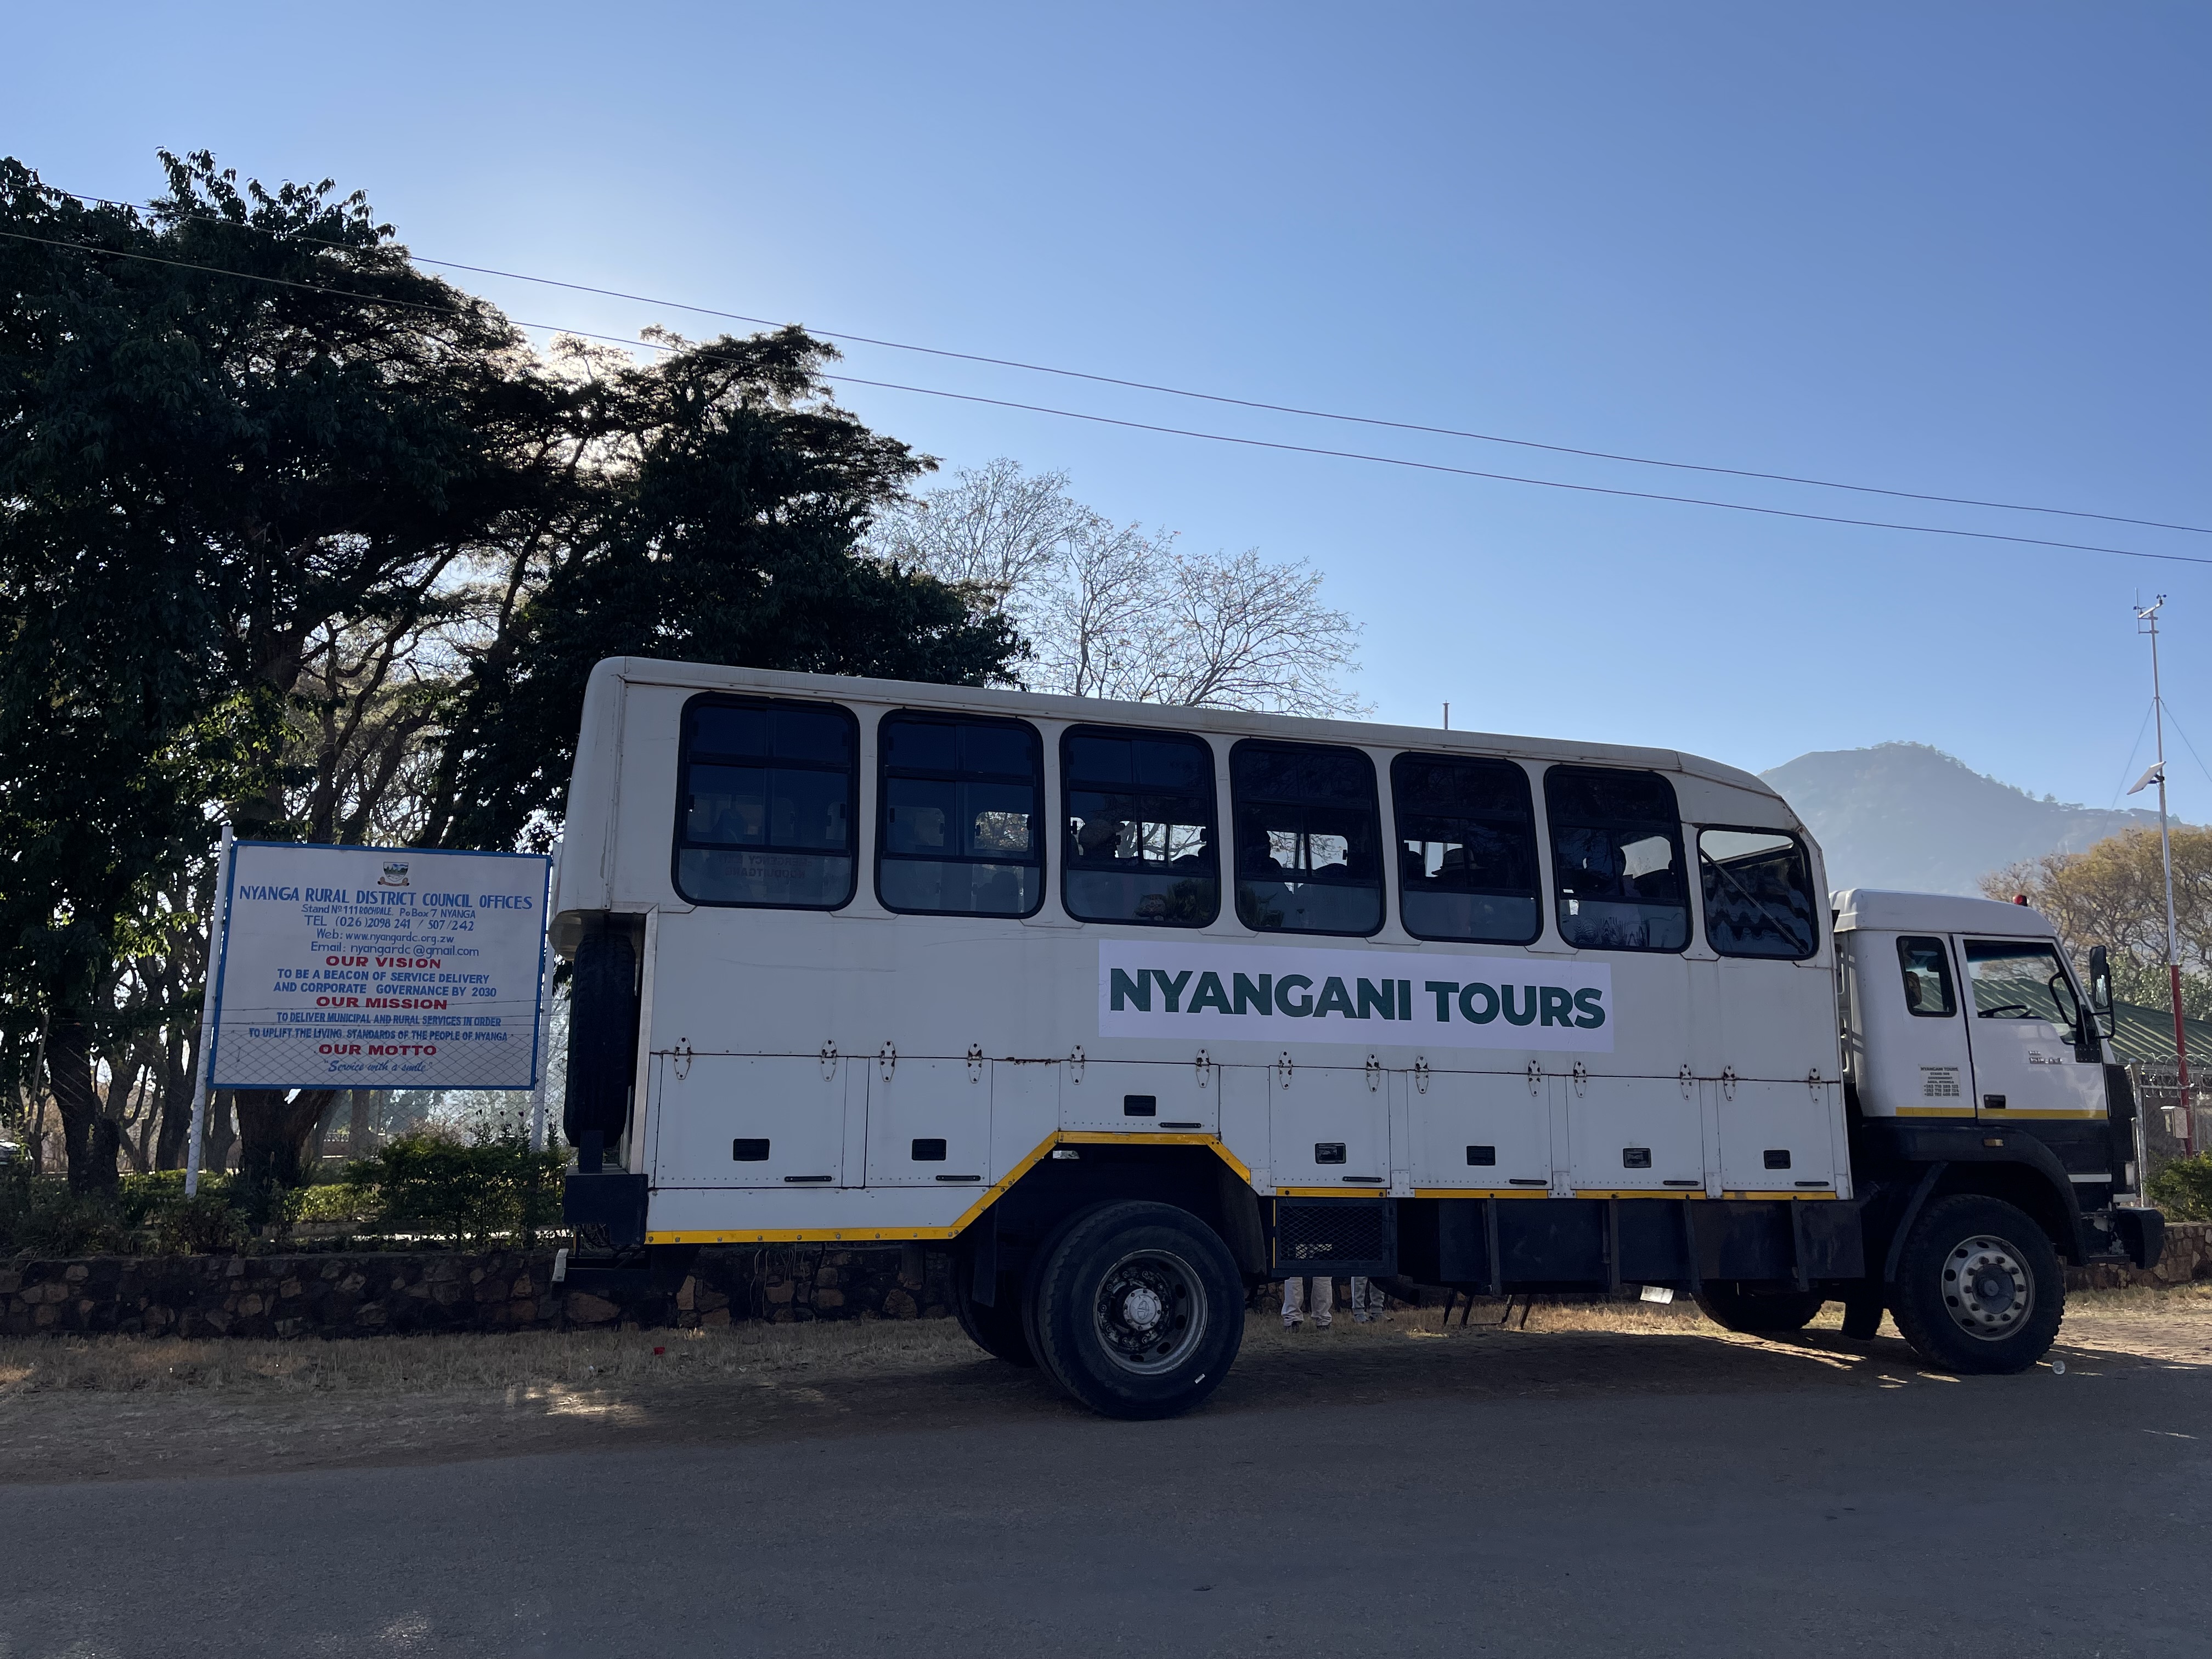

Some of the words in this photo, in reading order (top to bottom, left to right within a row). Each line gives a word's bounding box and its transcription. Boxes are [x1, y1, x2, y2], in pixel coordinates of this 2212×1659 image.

[240, 885, 300, 901] NYANGA
[305, 888, 349, 903] RURAL
[356, 890, 416, 905] DISTRICT
[422, 893, 472, 907] COUNCIL
[479, 895, 532, 909] OFFICES
[301, 904, 329, 913] Stand
[430, 909, 438, 917] 7
[441, 910, 475, 918] NYANGA
[304, 915, 328, 926] TEL
[394, 918, 410, 929] 241
[317, 928, 342, 939] Web:
[346, 932, 454, 945] www.nyangardc.org.zw
[311, 941, 345, 952] Email:
[326, 956, 369, 967] OUR
[375, 957, 441, 969] VISION
[278, 969, 292, 978] TO
[295, 969, 309, 979] BE
[312, 970, 320, 979] A
[324, 970, 369, 980] BEACON
[372, 972, 386, 981] OF
[391, 972, 435, 982] SERVICE
[439, 973, 489, 984] DELIVERY
[273, 982, 297, 992] AND
[300, 983, 366, 994] CORPORATE
[376, 984, 448, 996] GOVERNANCE
[452, 986, 467, 996] BY
[472, 987, 496, 997] 2030
[317, 996, 359, 1007] OUR
[365, 998, 447, 1009] MISSION
[1110, 968, 1411, 1020] NYANGANI
[1425, 980, 1606, 1029] TOURS
[276, 1012, 287, 1023] TO
[290, 1012, 325, 1023] DELIVER
[328, 1013, 371, 1024] MUNICIPAL
[374, 1014, 391, 1024] AND
[393, 1015, 420, 1024] RURAL
[422, 1015, 461, 1025] SERVICES
[464, 1017, 472, 1026] IN
[474, 1017, 501, 1026] ORDER
[249, 1028, 260, 1037] TO
[263, 1028, 292, 1037] UPLIFT
[295, 1028, 312, 1038] THE
[314, 1028, 342, 1039] LIVING
[347, 1029, 395, 1039] STANDARDS
[398, 1030, 409, 1040] OF
[411, 1030, 427, 1040] THE
[430, 1031, 460, 1041] PEOPLE
[462, 1031, 473, 1041] OF
[475, 1032, 507, 1041] NYANGA
[319, 1044, 362, 1055] OUR
[368, 1045, 437, 1056] MOTTO
[368, 1059, 390, 1070] with
